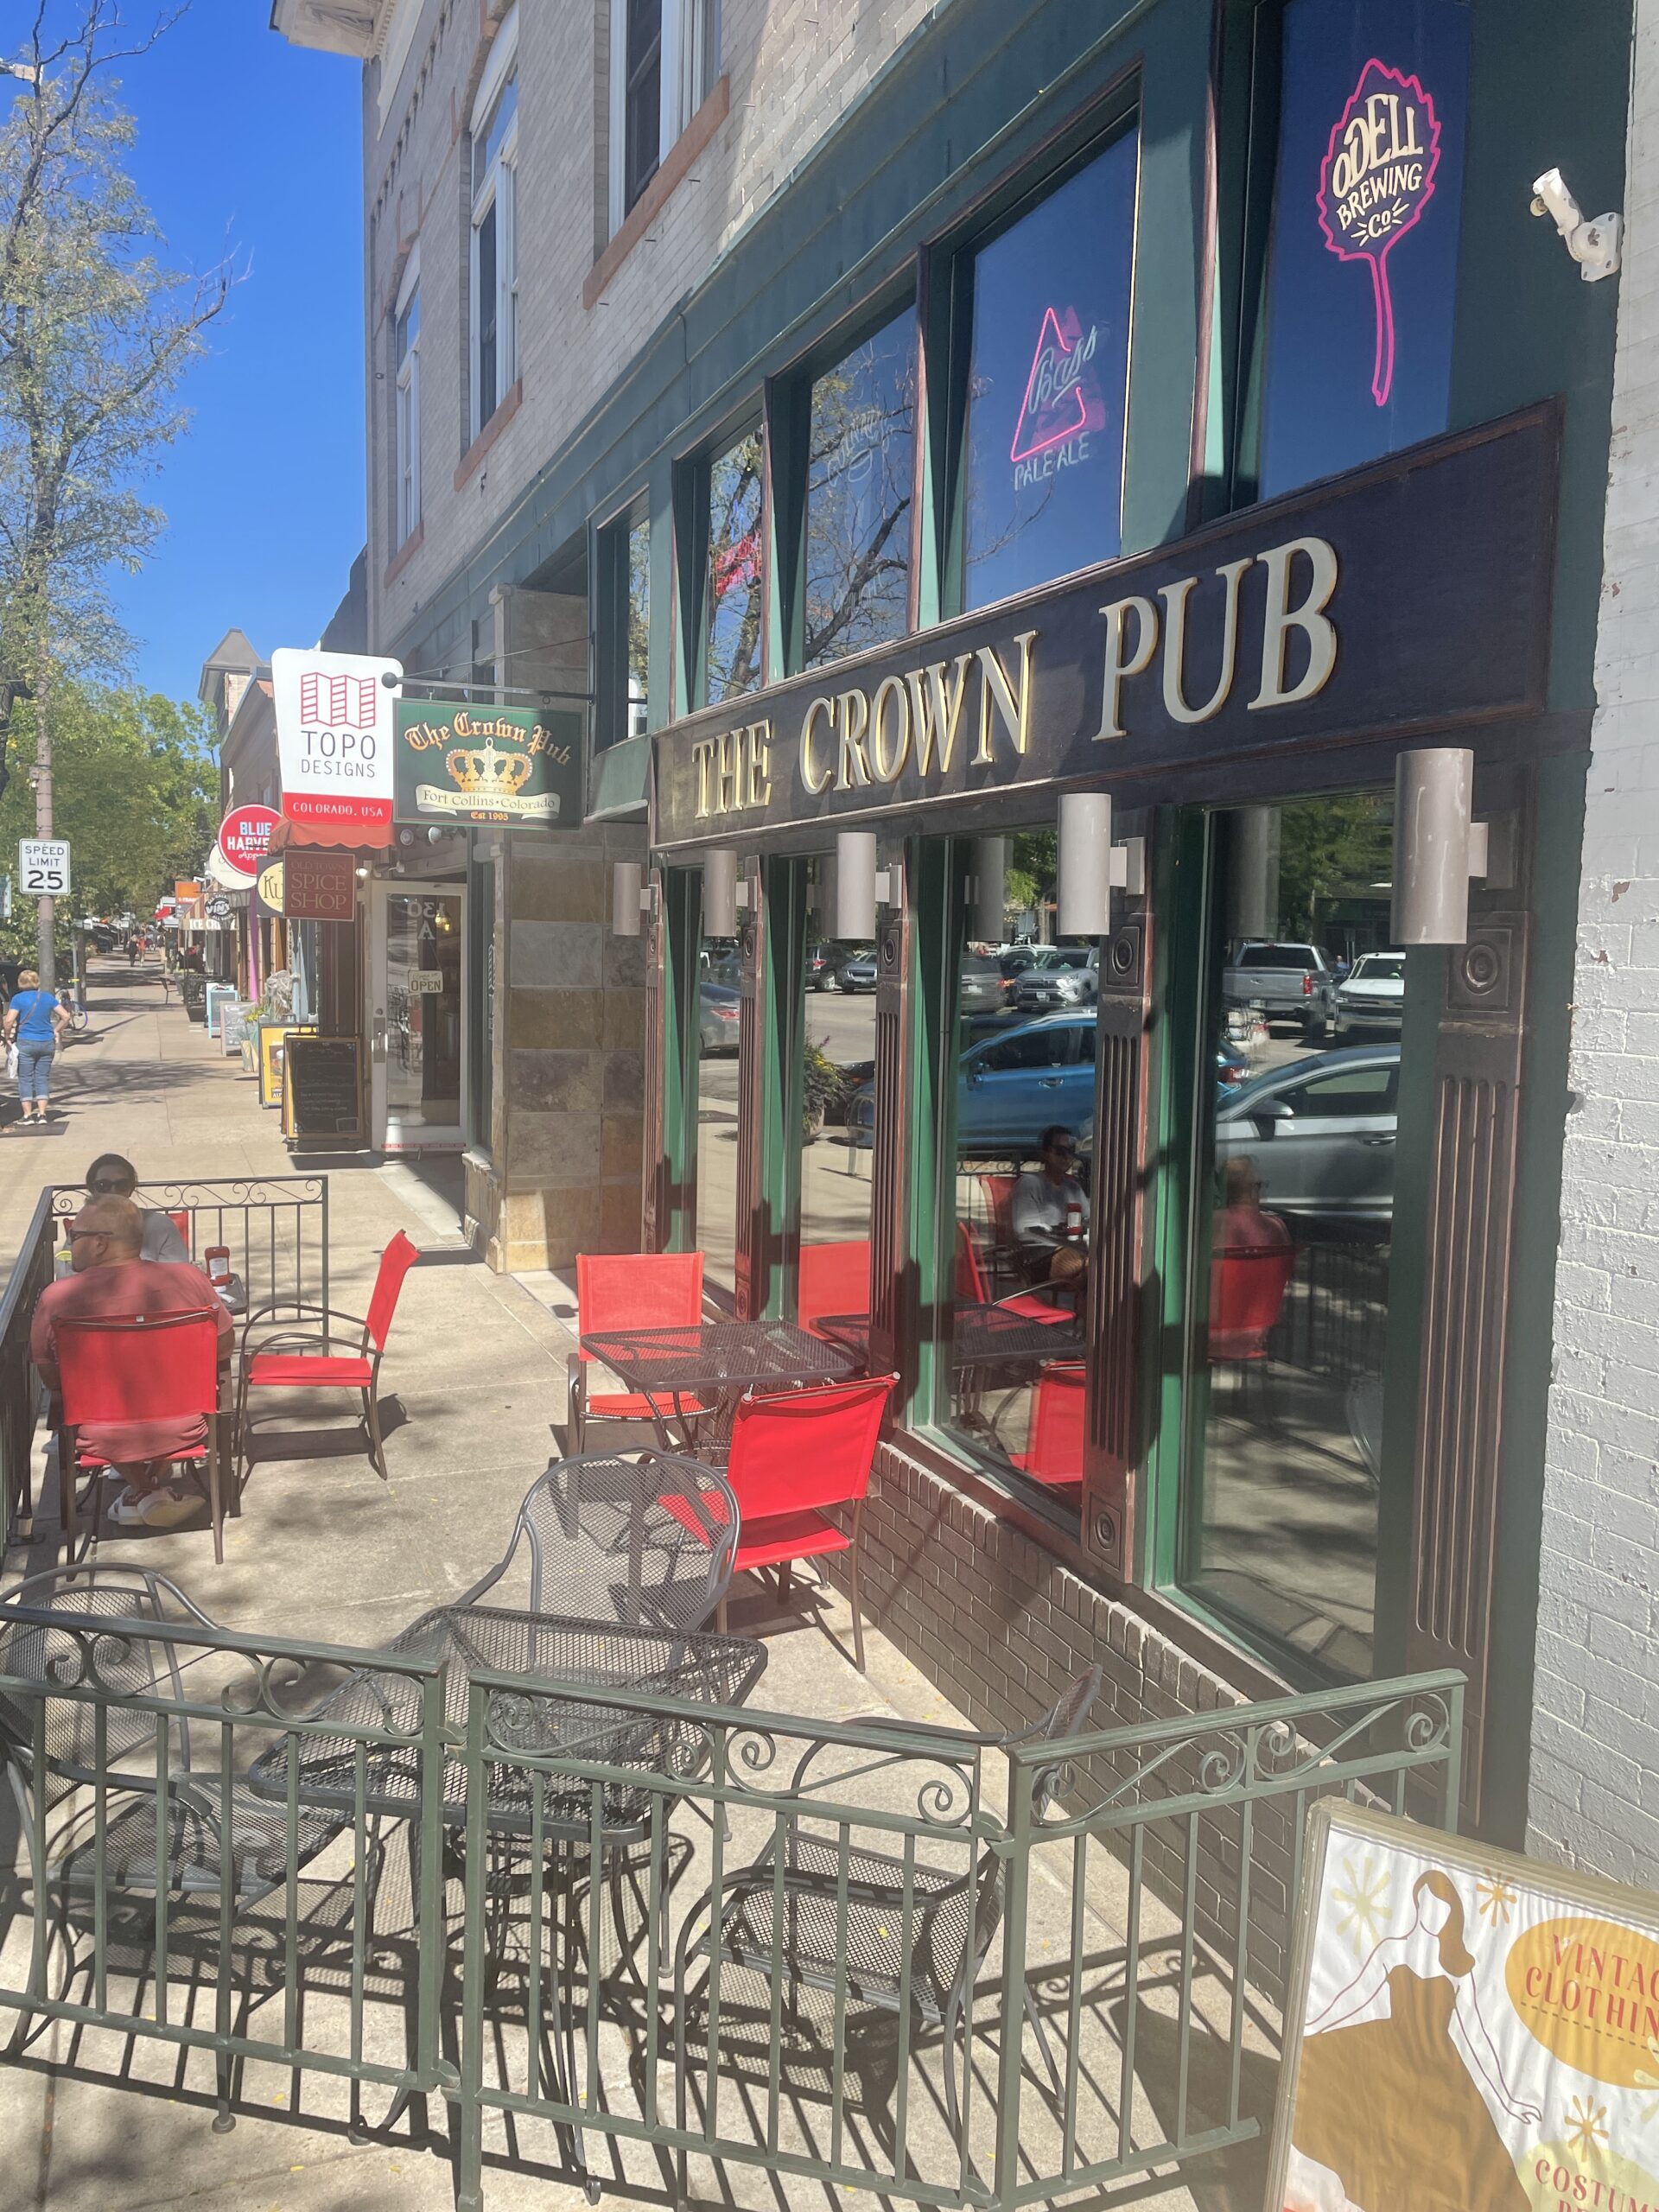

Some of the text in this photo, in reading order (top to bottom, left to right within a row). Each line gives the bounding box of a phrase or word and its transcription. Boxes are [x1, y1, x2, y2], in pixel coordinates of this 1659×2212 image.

[1332, 93, 1424, 198] ODELL
[1337, 162, 1423, 231] BREWING
[1013, 431, 1090, 492] PALE ALE
[692, 536, 1338, 819] THE CROWN PUB
[301, 730, 376, 760] TOPO
[404, 721, 450, 751] The
[453, 711, 527, 743] Crown
[527, 724, 571, 766] Pub
[301, 759, 376, 779] DESIGNS
[423, 790, 448, 804] Fort
[361, 805, 384, 817] USA
[239, 822, 272, 836] BLUE
[24, 845, 65, 855] SPEED
[29, 857, 60, 867] LIMIT
[28, 869, 63, 889] 25
[290, 872, 346, 891] SPICE
[290, 892, 346, 910] SHOP
[410, 980, 442, 992] OPEN
[1535, 2159, 1659, 2212] COSTUM
